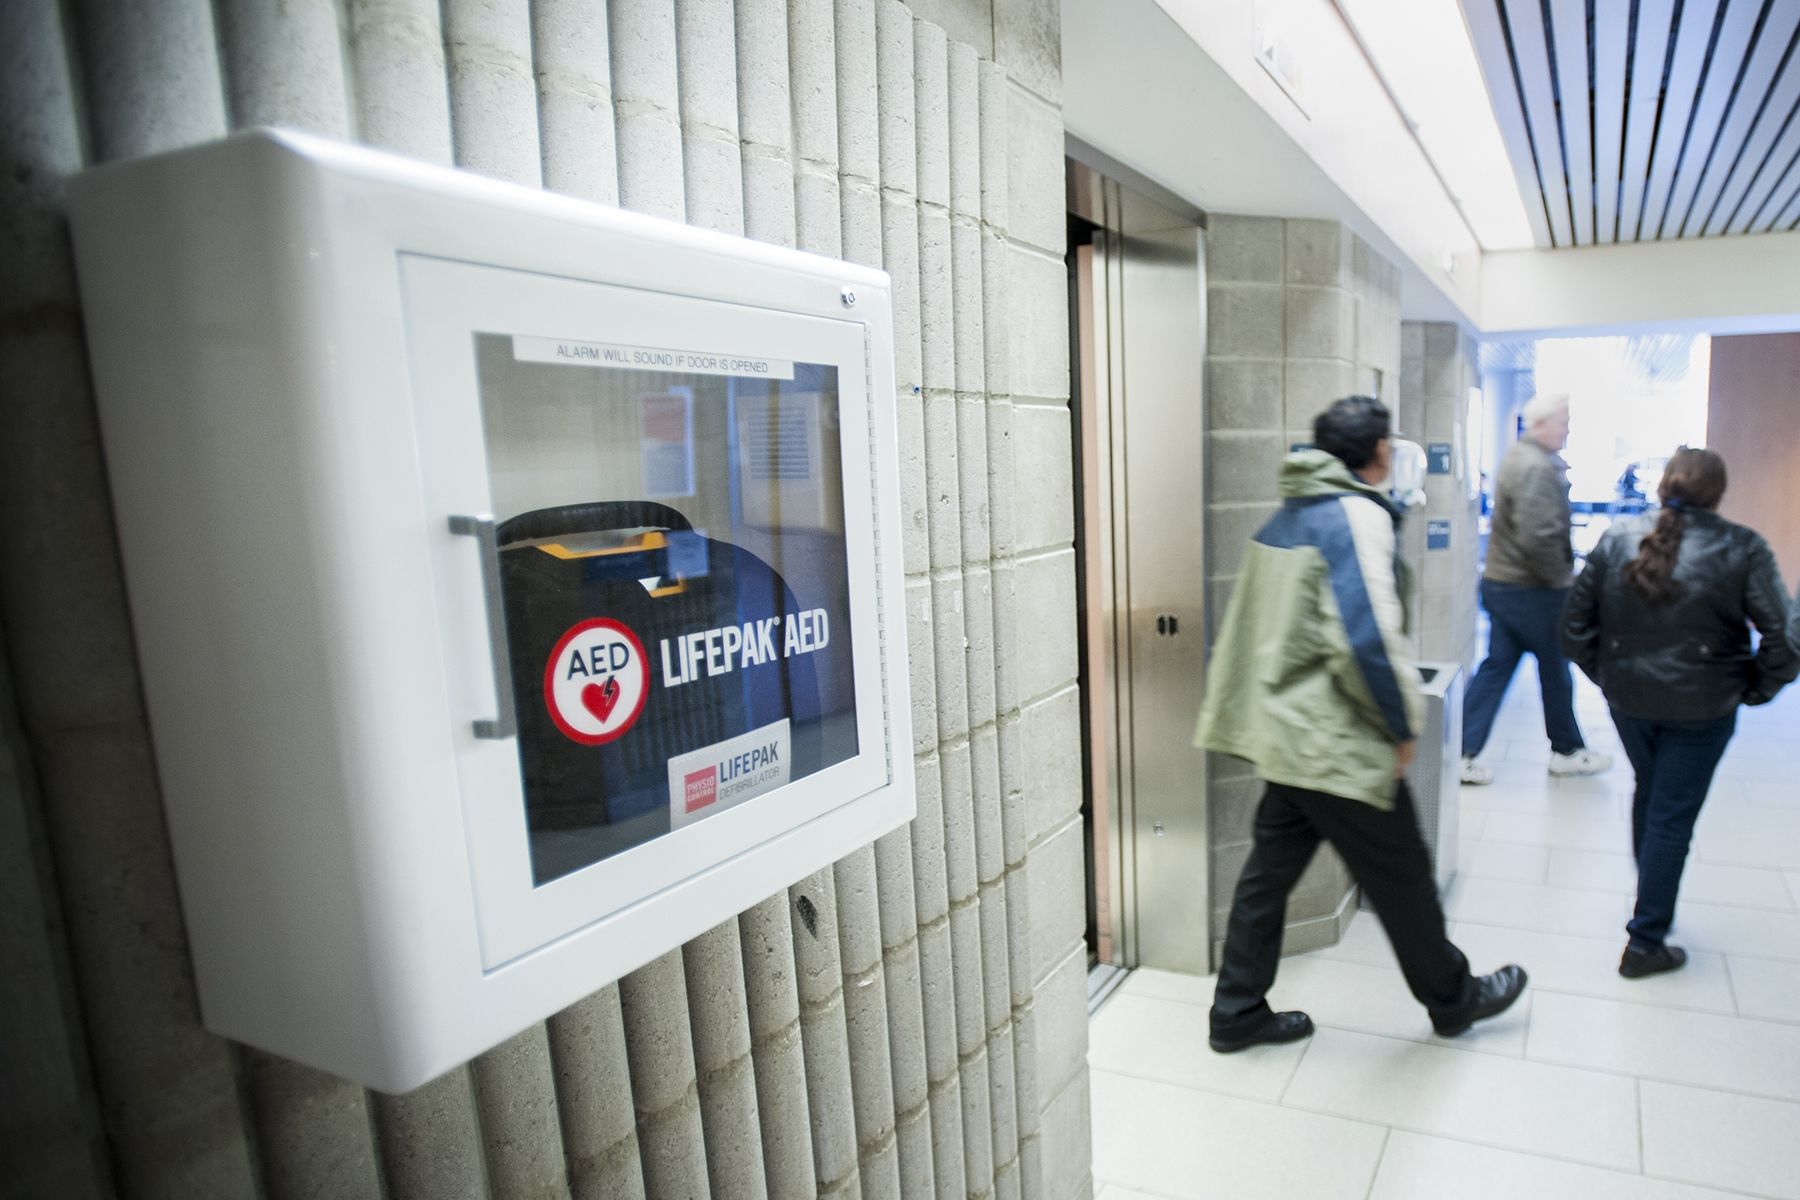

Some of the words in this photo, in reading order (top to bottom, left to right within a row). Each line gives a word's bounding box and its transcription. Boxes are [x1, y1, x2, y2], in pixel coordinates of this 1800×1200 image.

[556, 344, 599, 360] ALARM
[603, 349, 630, 363] WILL
[633, 351, 673, 366] SOUND
[675, 355, 685, 367] IF
[688, 355, 718, 369] DOOR
[719, 358, 729, 370] IS
[730, 359, 769, 374] OPENED
[784, 608, 829, 658] AED
[566, 641, 630, 681] AED
[720, 741, 779, 784] LIFEPAK
[687, 775, 715, 795] PHYSIO
[719, 766, 780, 801] DEFIBRILLATOR
